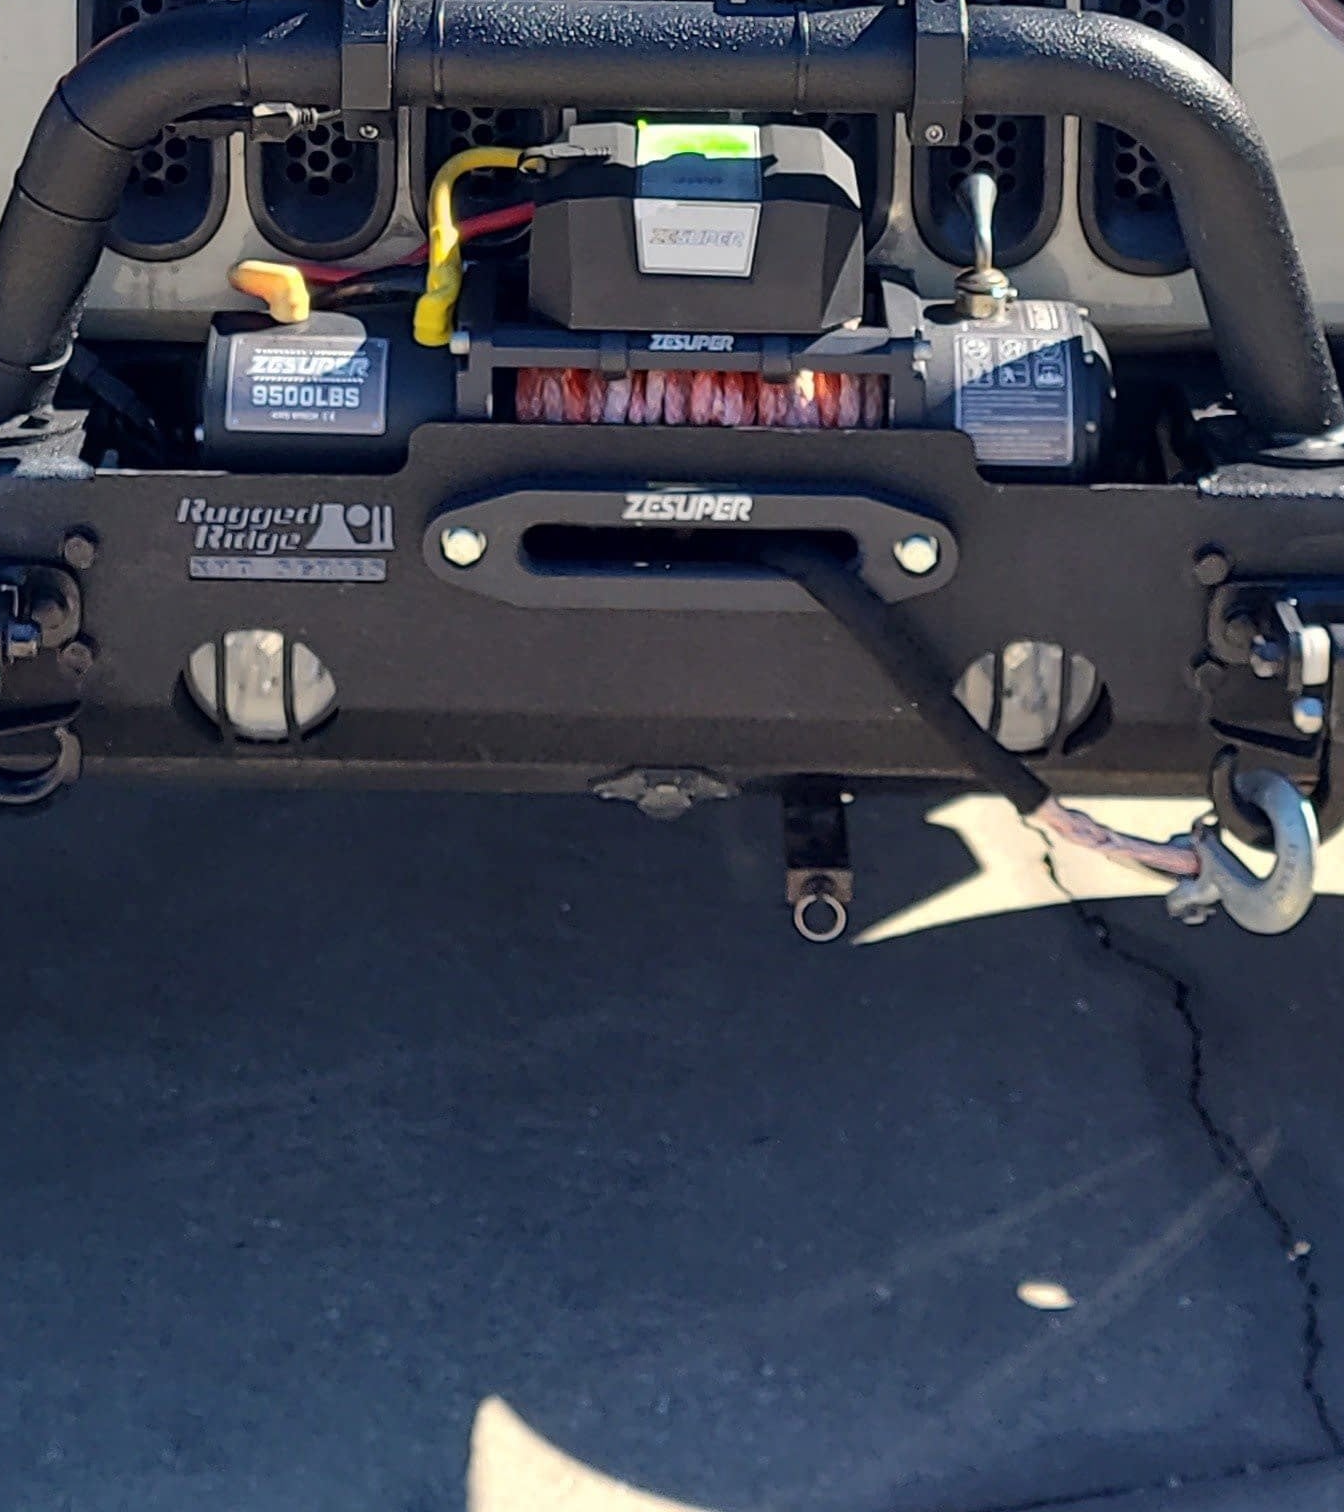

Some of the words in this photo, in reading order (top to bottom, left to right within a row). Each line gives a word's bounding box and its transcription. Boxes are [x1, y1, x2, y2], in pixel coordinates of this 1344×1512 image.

[648, 334, 735, 352] ZESUPER
[247, 355, 371, 378] ZESUPER
[252, 384, 361, 408] 9500LBS
[177, 497, 320, 530] Rugged
[621, 493, 754, 522] ZESUPER
[194, 524, 301, 555] Ridge
